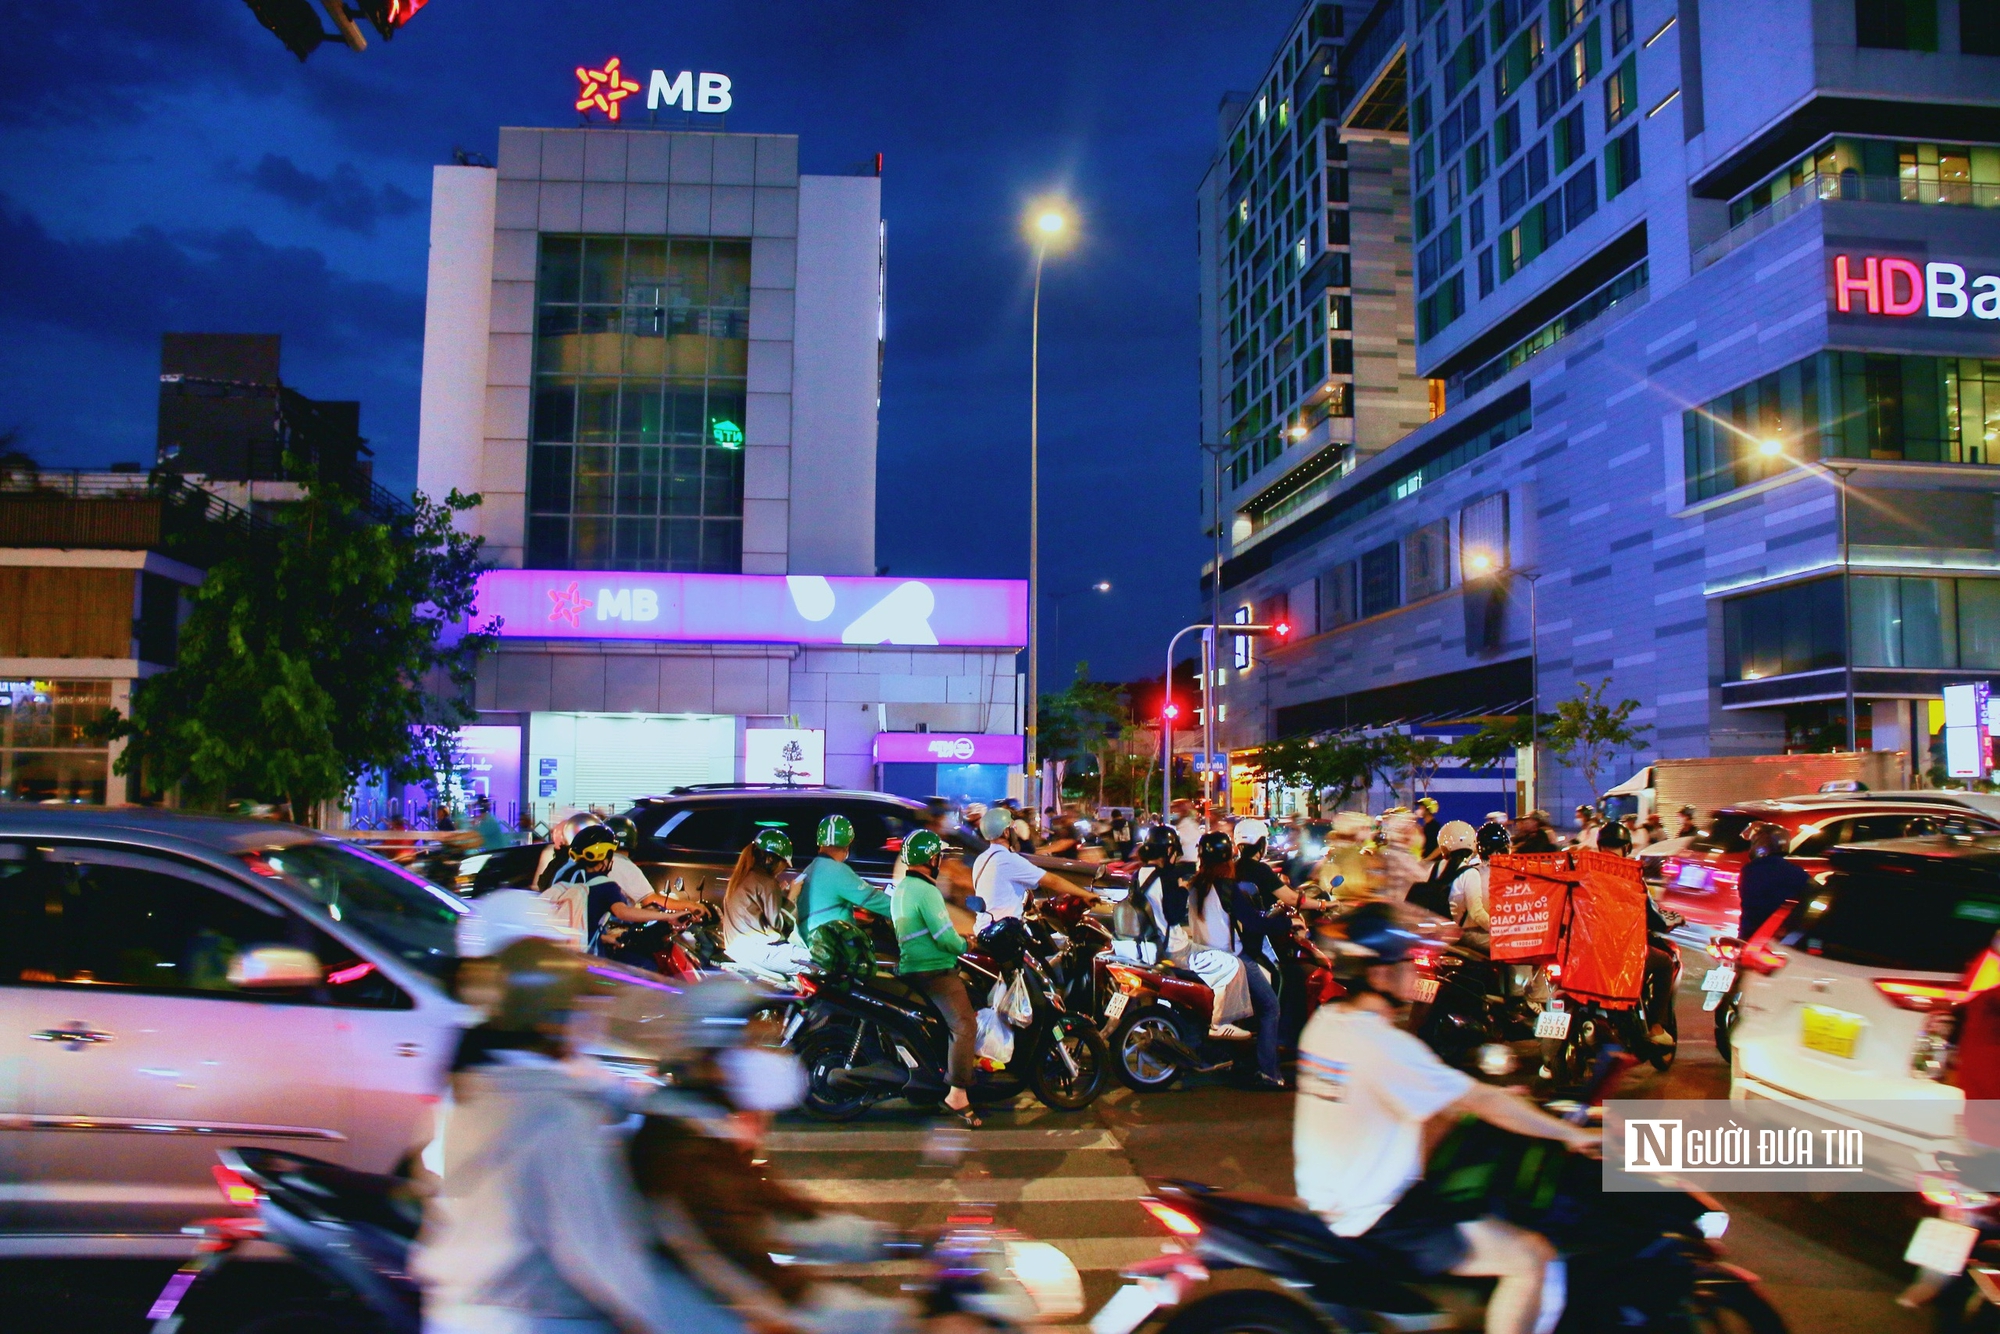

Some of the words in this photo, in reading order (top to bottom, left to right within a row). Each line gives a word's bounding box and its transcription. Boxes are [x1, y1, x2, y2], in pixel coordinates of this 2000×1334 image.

[647, 69, 733, 113] MB
[596, 588, 659, 621] MB
[766, 840, 784, 851] Grab
[924, 842, 938, 855] Grab
[1490, 915, 1516, 925] GIAO
[1518, 911, 1549, 923] HÀNG
[1543, 1015, 1567, 1026] 59-F2
